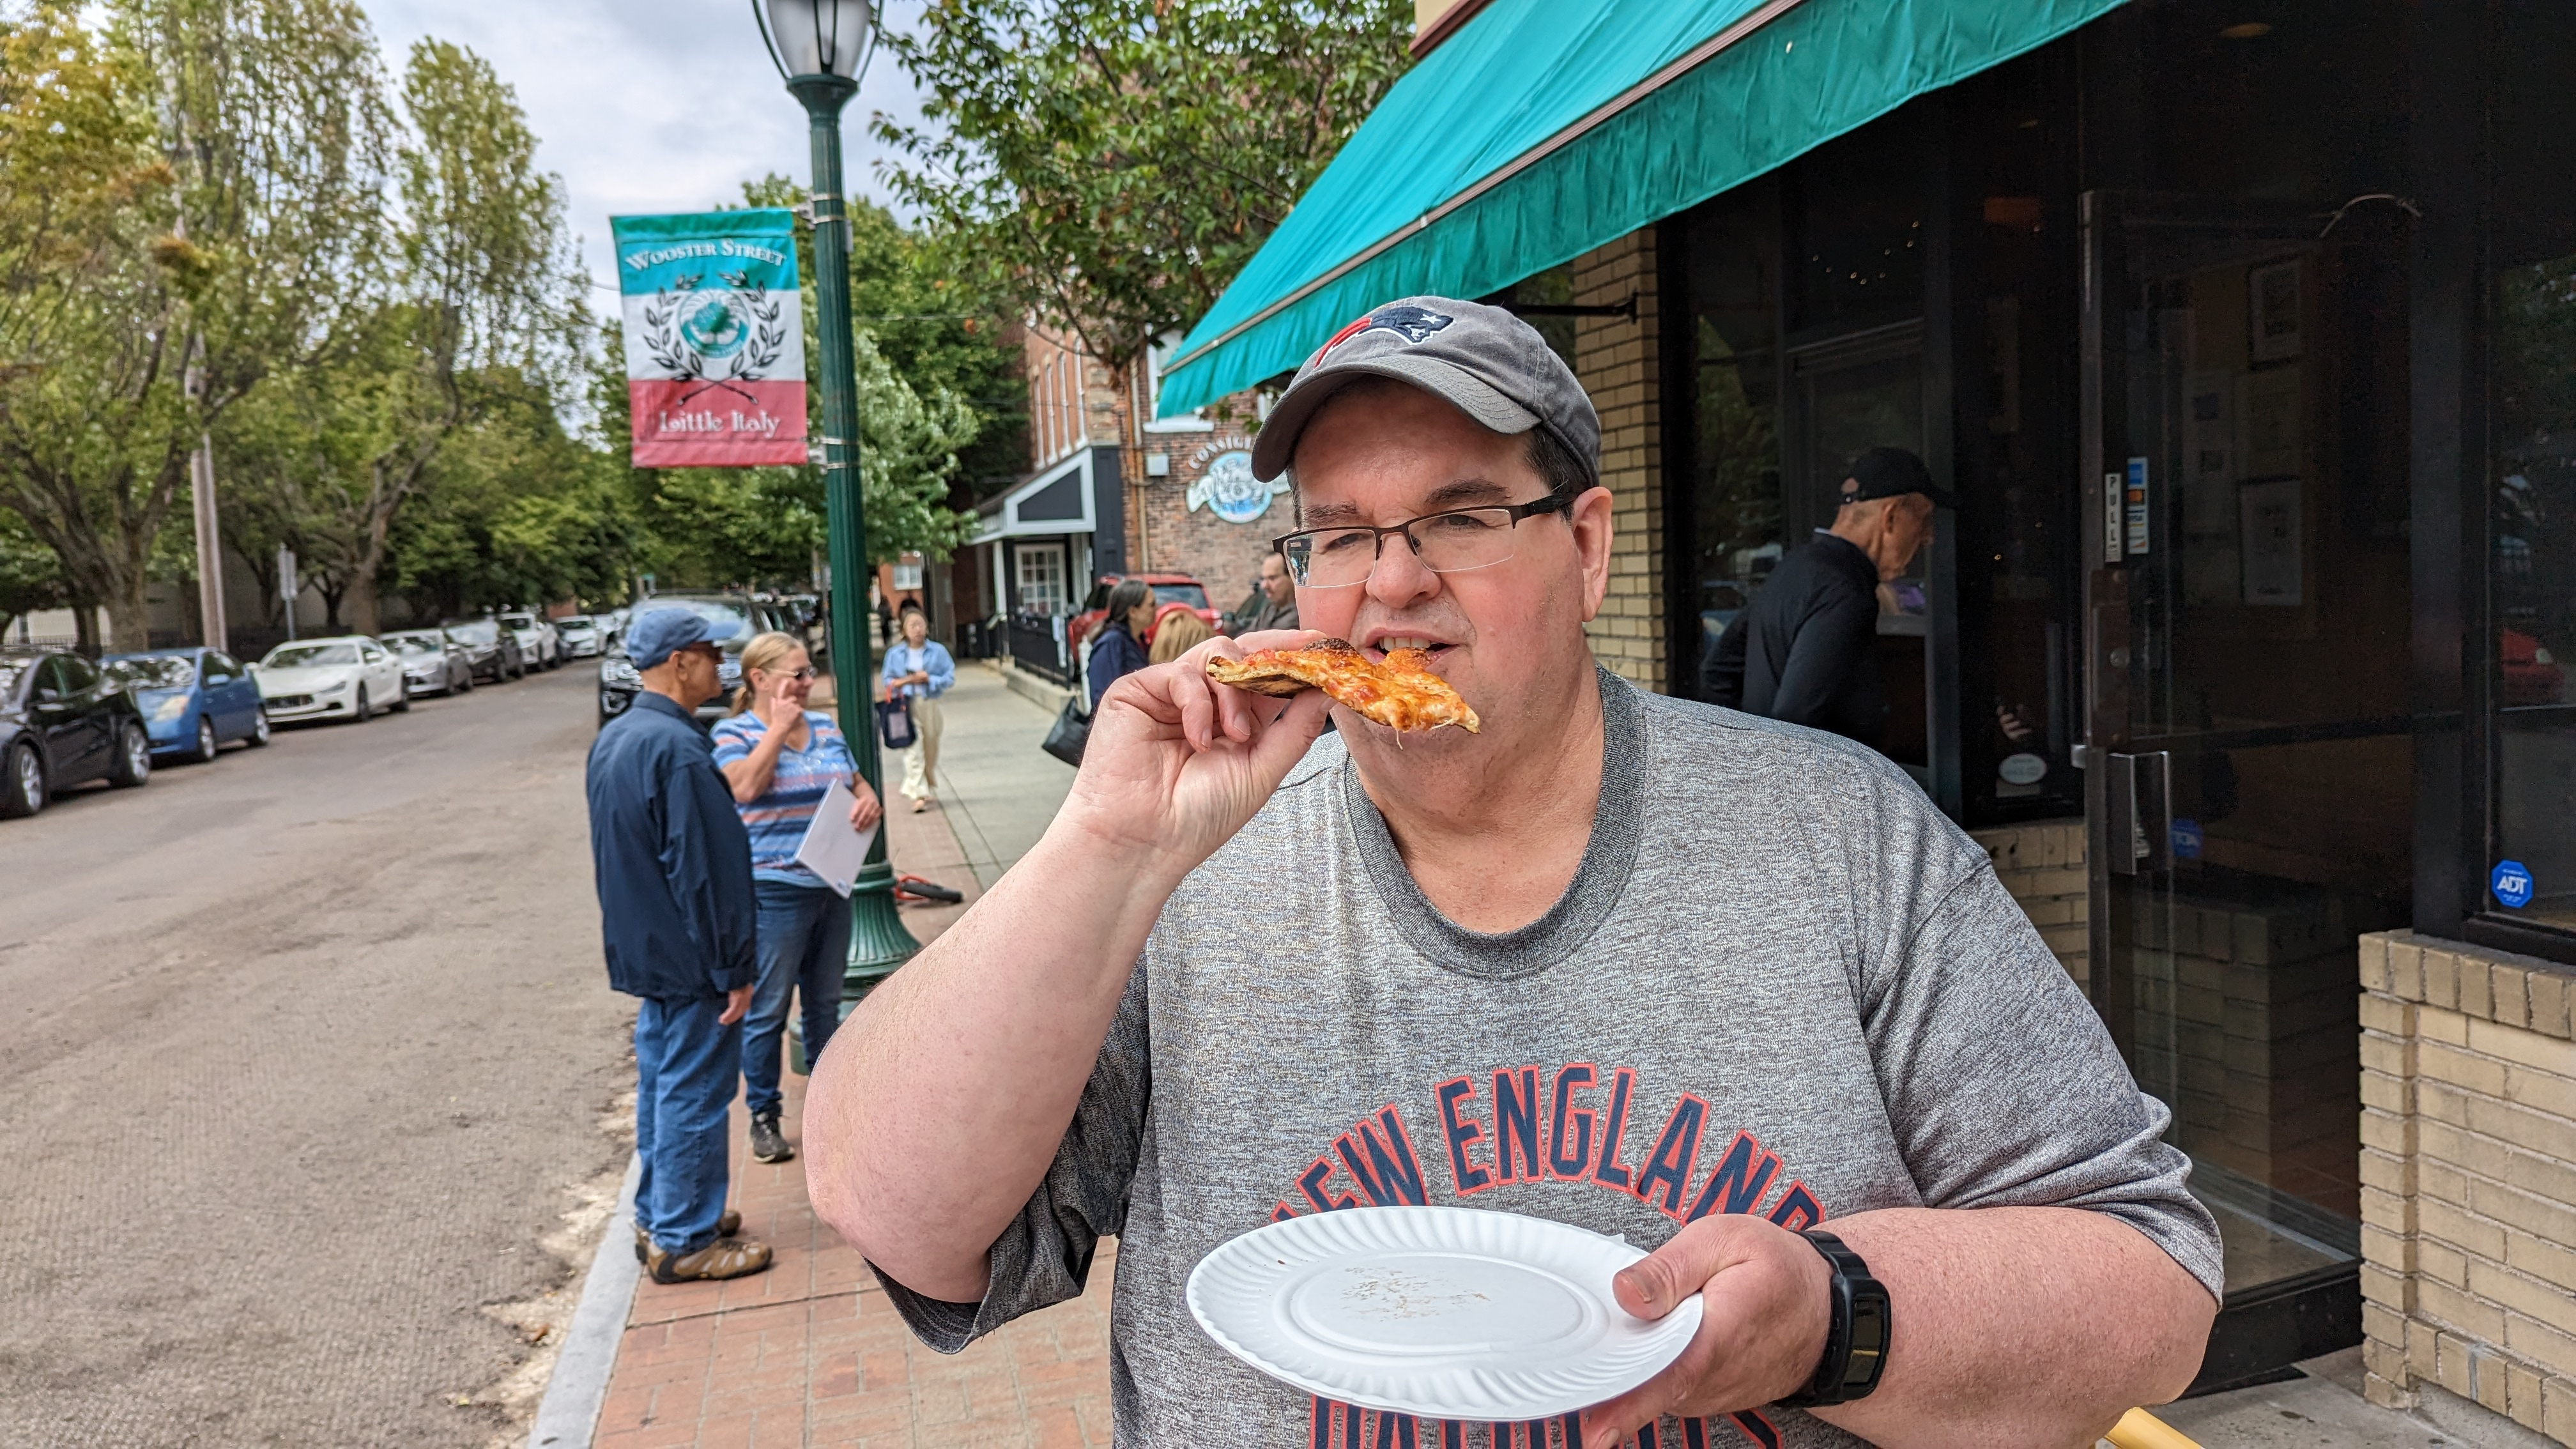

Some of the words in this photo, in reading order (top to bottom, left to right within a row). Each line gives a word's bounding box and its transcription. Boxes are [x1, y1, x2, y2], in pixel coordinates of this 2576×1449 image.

[659, 411, 724, 433] Little
[730, 410, 781, 438] Italy
[2497, 875, 2527, 894] ADT
